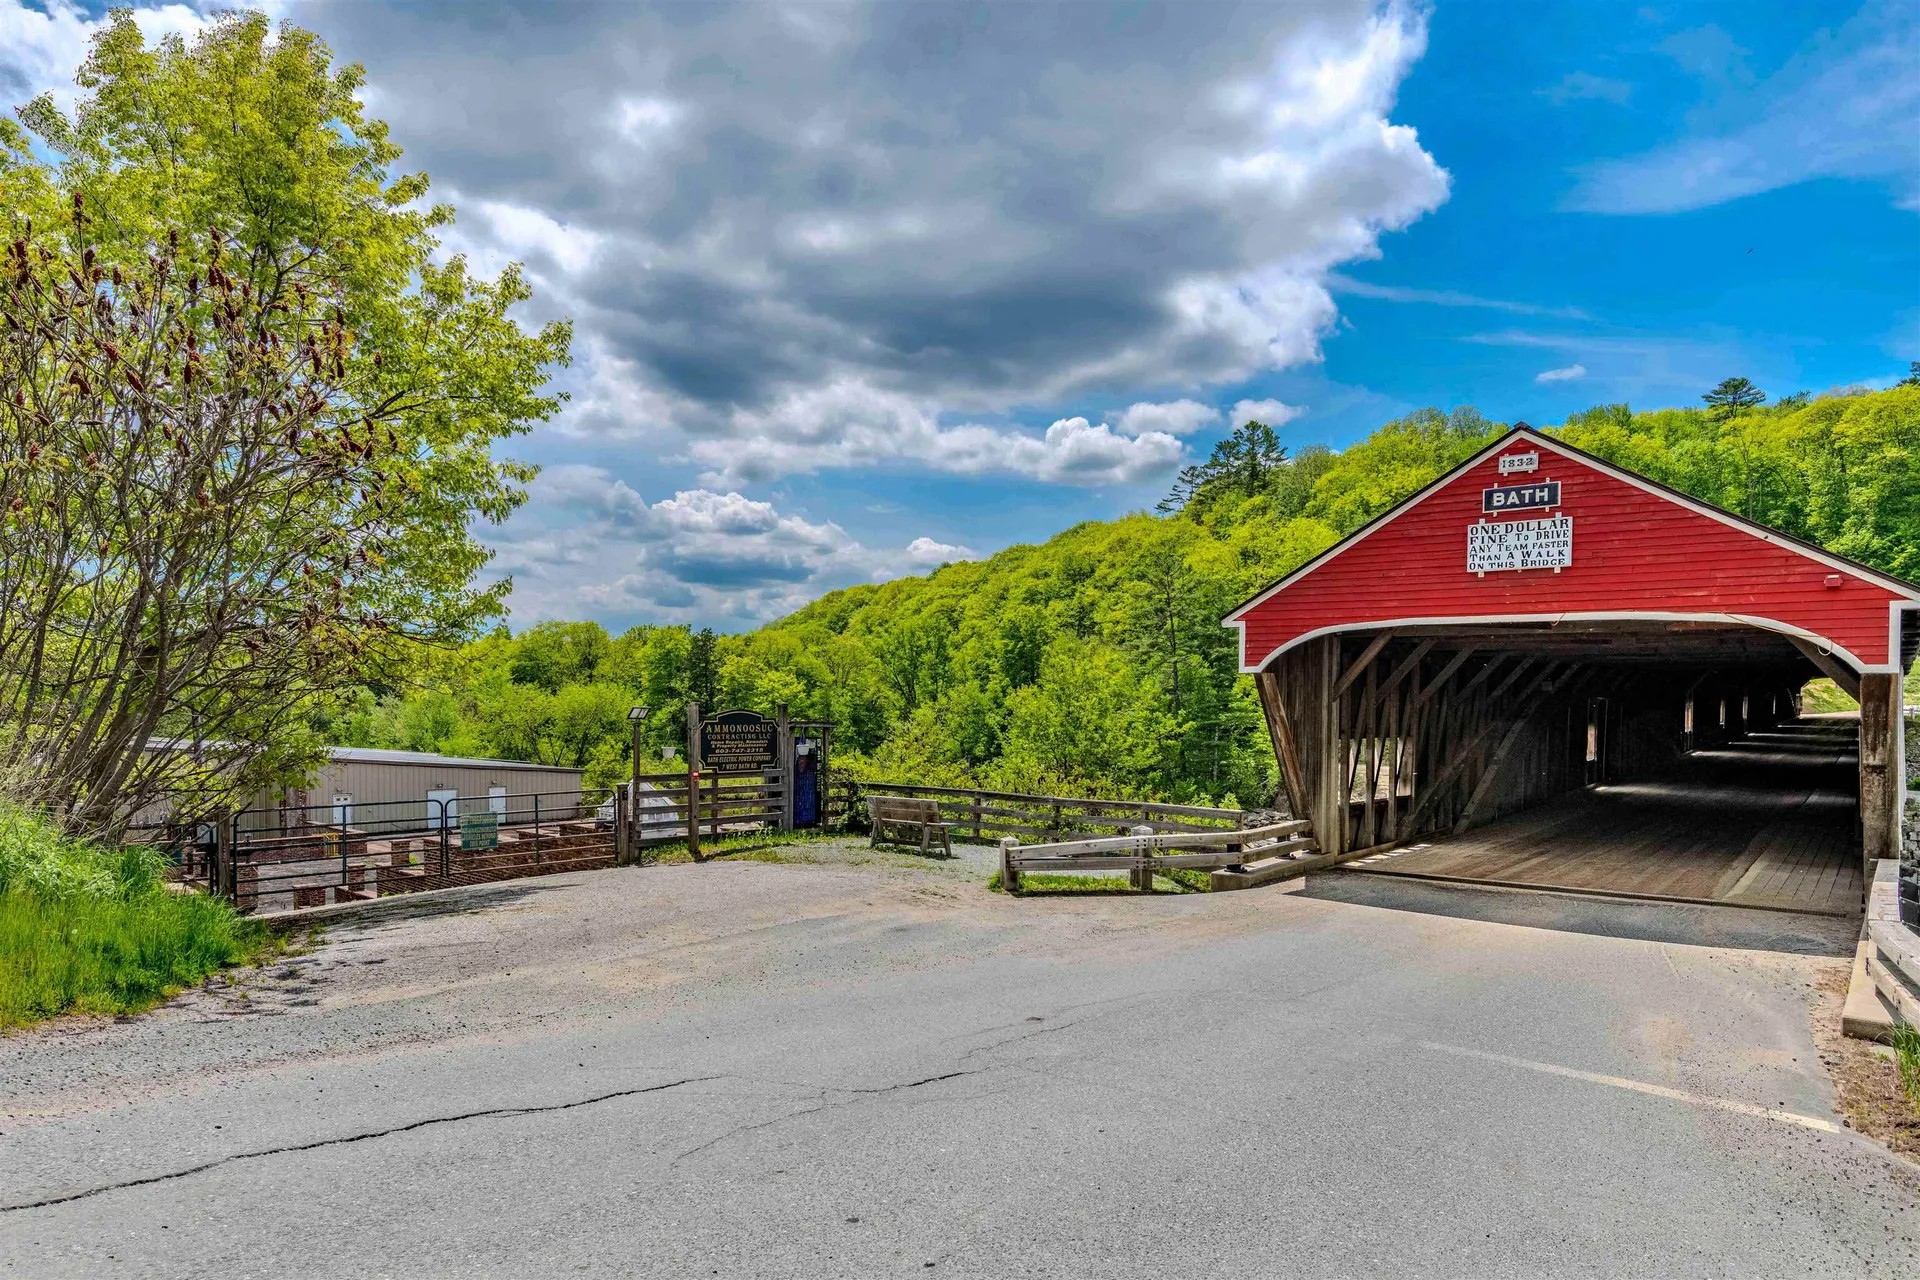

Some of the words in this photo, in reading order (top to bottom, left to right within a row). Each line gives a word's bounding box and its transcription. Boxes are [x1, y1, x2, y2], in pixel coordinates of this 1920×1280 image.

[1502, 457, 1533, 468] 1832
[1493, 487, 1549, 506] BATH
[1470, 524, 1500, 535] ONE
[1505, 518, 1569, 534] DOLLAR
[1470, 534, 1507, 545] FINE
[1536, 529, 1569, 541] DRIVE
[1469, 544, 1493, 554] ANY
[1497, 543, 1528, 552] TEAM
[1532, 540, 1569, 549] FASTER
[1469, 554, 1500, 562] THAN
[1506, 551, 1515, 560] A
[1521, 549, 1565, 559] WALK
[1469, 562, 1484, 570] ON
[1489, 561, 1515, 569] THIS
[1521, 558, 1565, 567] BRIDGE
[706, 724, 773, 733] AMMONOOSUC
